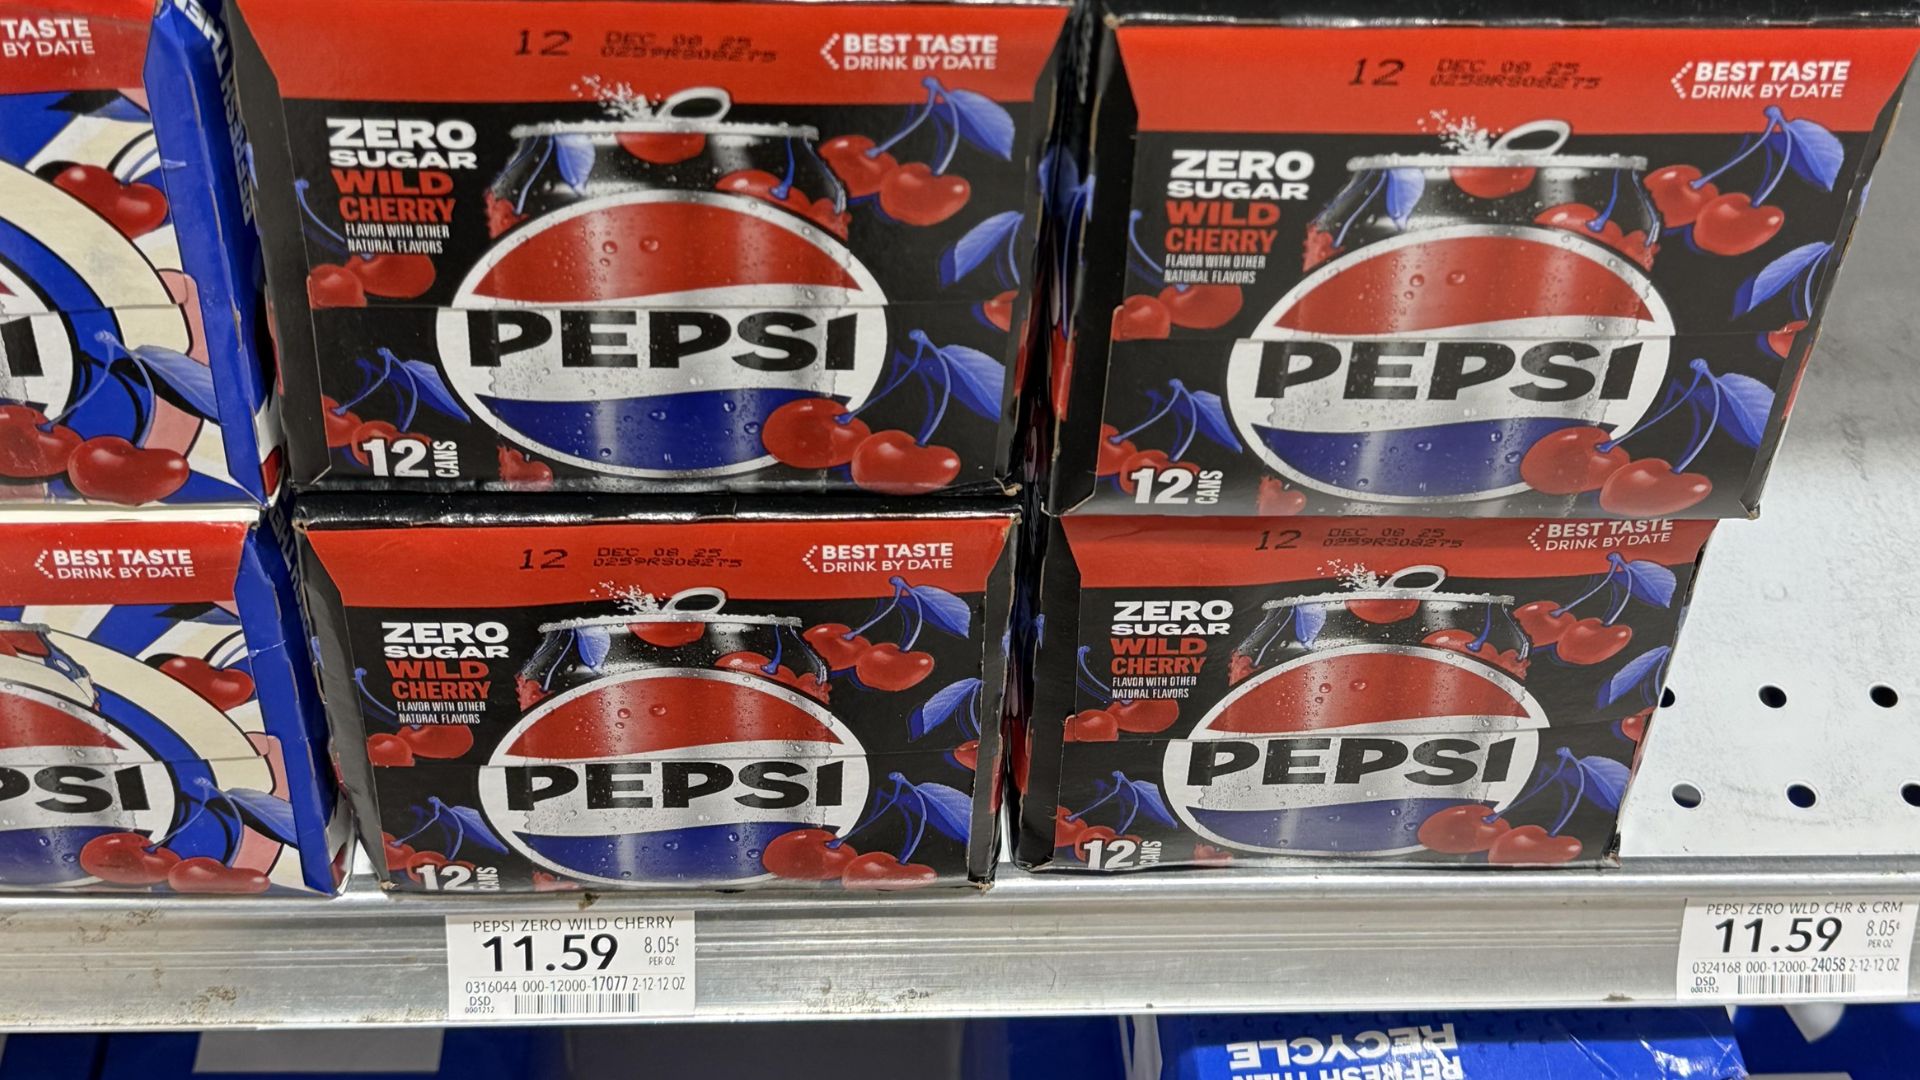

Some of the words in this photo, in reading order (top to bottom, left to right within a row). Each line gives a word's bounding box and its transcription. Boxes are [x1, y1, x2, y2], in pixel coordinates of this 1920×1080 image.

[0, 18, 92, 39] TASTE
[514, 30, 572, 56] 12
[605, 31, 656, 46] DEC
[843, 33, 912, 53] BEST
[916, 34, 998, 54] TASTE
[2, 41, 31, 57] BY
[36, 40, 95, 56] DATE
[844, 55, 908, 70] DRINK
[912, 56, 940, 70] BY
[943, 55, 996, 70] DATE
[1436, 59, 1486, 73] DEC
[1695, 61, 1765, 82] BEST
[1769, 61, 1850, 81] TASTE
[1348, 58, 1404, 86] 12
[1691, 84, 1755, 99] DRINK
[1759, 84, 1788, 98] BY
[1789, 83, 1845, 97] DATE
[326, 118, 477, 149] ZERO
[329, 150, 477, 169] SUGAR
[1170, 150, 1315, 180] ZERO
[331, 169, 454, 195] WILD
[1167, 181, 1309, 200] SUGAR
[338, 196, 456, 222] CHERRY
[1166, 201, 1280, 226] WILD
[345, 222, 385, 237] FLAVOR
[387, 223, 413, 237] WITH
[416, 224, 450, 238] OTHER
[347, 239, 394, 253] NATURAL
[397, 240, 443, 254] FLAVORS
[1165, 227, 1278, 253] CHERRY
[1165, 253, 1203, 267] FLAVOR
[1205, 255, 1232, 268] WITH
[1233, 255, 1266, 269] OTHER
[1164, 269, 1208, 283] NATURAL
[1212, 270, 1256, 285] FLAVORS
[466, 309, 858, 371] PEPSI
[1255, 340, 1643, 402] PEPSI
[362, 438, 430, 478] 12
[433, 440, 460, 478] CANS
[1131, 468, 1193, 504] 12
[1195, 470, 1223, 504] CANS
[1328, 528, 1368, 537] DEC
[1382, 528, 1405, 537] 08
[1419, 528, 1446, 538] 25
[1547, 522, 1603, 538] BEST
[1609, 519, 1673, 535] TASTE
[1255, 530, 1302, 550] 12
[1545, 538, 1597, 550] DRINK
[1602, 536, 1625, 548] BY
[1627, 532, 1671, 546] DATE
[53, 550, 113, 566] BEST
[117, 549, 193, 565] TASTE
[520, 549, 568, 570] 12
[598, 548, 639, 557] DEC
[653, 548, 679, 557] 08
[695, 548, 722, 558] 25
[822, 545, 879, 560] BEST
[884, 543, 953, 558] TASTE
[56, 567, 116, 579] DRINK
[119, 567, 144, 578] BY
[147, 566, 195, 577] DATE
[823, 561, 877, 573] DRINK
[882, 560, 904, 571] BY
[907, 559, 953, 570] DATE
[1113, 600, 1234, 621] ZERO
[381, 621, 509, 643] ZERO
[1111, 623, 1231, 635] SUGAR
[383, 645, 509, 658] SUGAR
[1110, 637, 1208, 655] WILD
[386, 660, 489, 679] WILD
[1111, 657, 1207, 675] CHERRY
[392, 681, 491, 699] CHERRY
[1112, 677, 1143, 687] FLAVOR
[1146, 677, 1168, 687] WITH
[1169, 676, 1197, 686] OTHER
[1112, 688, 1149, 699] NATURAL
[1152, 688, 1189, 698] FLAVORS
[397, 701, 430, 711] FLAVOR
[432, 701, 455, 711] WITH
[457, 701, 486, 711] OTHER
[399, 713, 438, 723] NATURAL
[441, 713, 480, 724] FLAVORS
[1187, 737, 1516, 786] PEPSI
[505, 761, 844, 811] PEPSI
[1083, 840, 1136, 870] 12
[1139, 840, 1162, 866] CANS
[416, 864, 474, 890] 12
[476, 867, 500, 890] CANS
[1707, 904, 1744, 915] PEPSI
[1748, 903, 1784, 915] ZERO
[1789, 902, 1820, 914] WLD
[1824, 902, 1852, 913] CHR
[1857, 902, 1867, 913] &
[1872, 901, 1904, 913] CRM
[473, 920, 514, 932] PEPSI
[521, 919, 562, 931] ZERO
[569, 917, 608, 930] WILD
[614, 916, 676, 929] CHERRY
[1715, 916, 1842, 953] 11.59
[482, 933, 618, 972] 11.59
[1867, 940, 1881, 948] PER
[1883, 940, 1893, 948] OZ
[649, 957, 663, 966] PER
[665, 957, 676, 966] OZ
[1692, 961, 1741, 973] 0324168
[1746, 957, 1846, 973] 000-12000-24058
[1849, 958, 1884, 972] 2-12-12
[1887, 958, 1900, 971] OZ
[465, 981, 517, 993] 0316044
[523, 976, 628, 992] 000-12000-17077
[632, 977, 669, 990] 2-12-12
[672, 977, 686, 990] OZ
[1695, 976, 1716, 986] DSD
[469, 996, 491, 1006] DSD
[1226, 1023, 1458, 1070] RECYCLE
